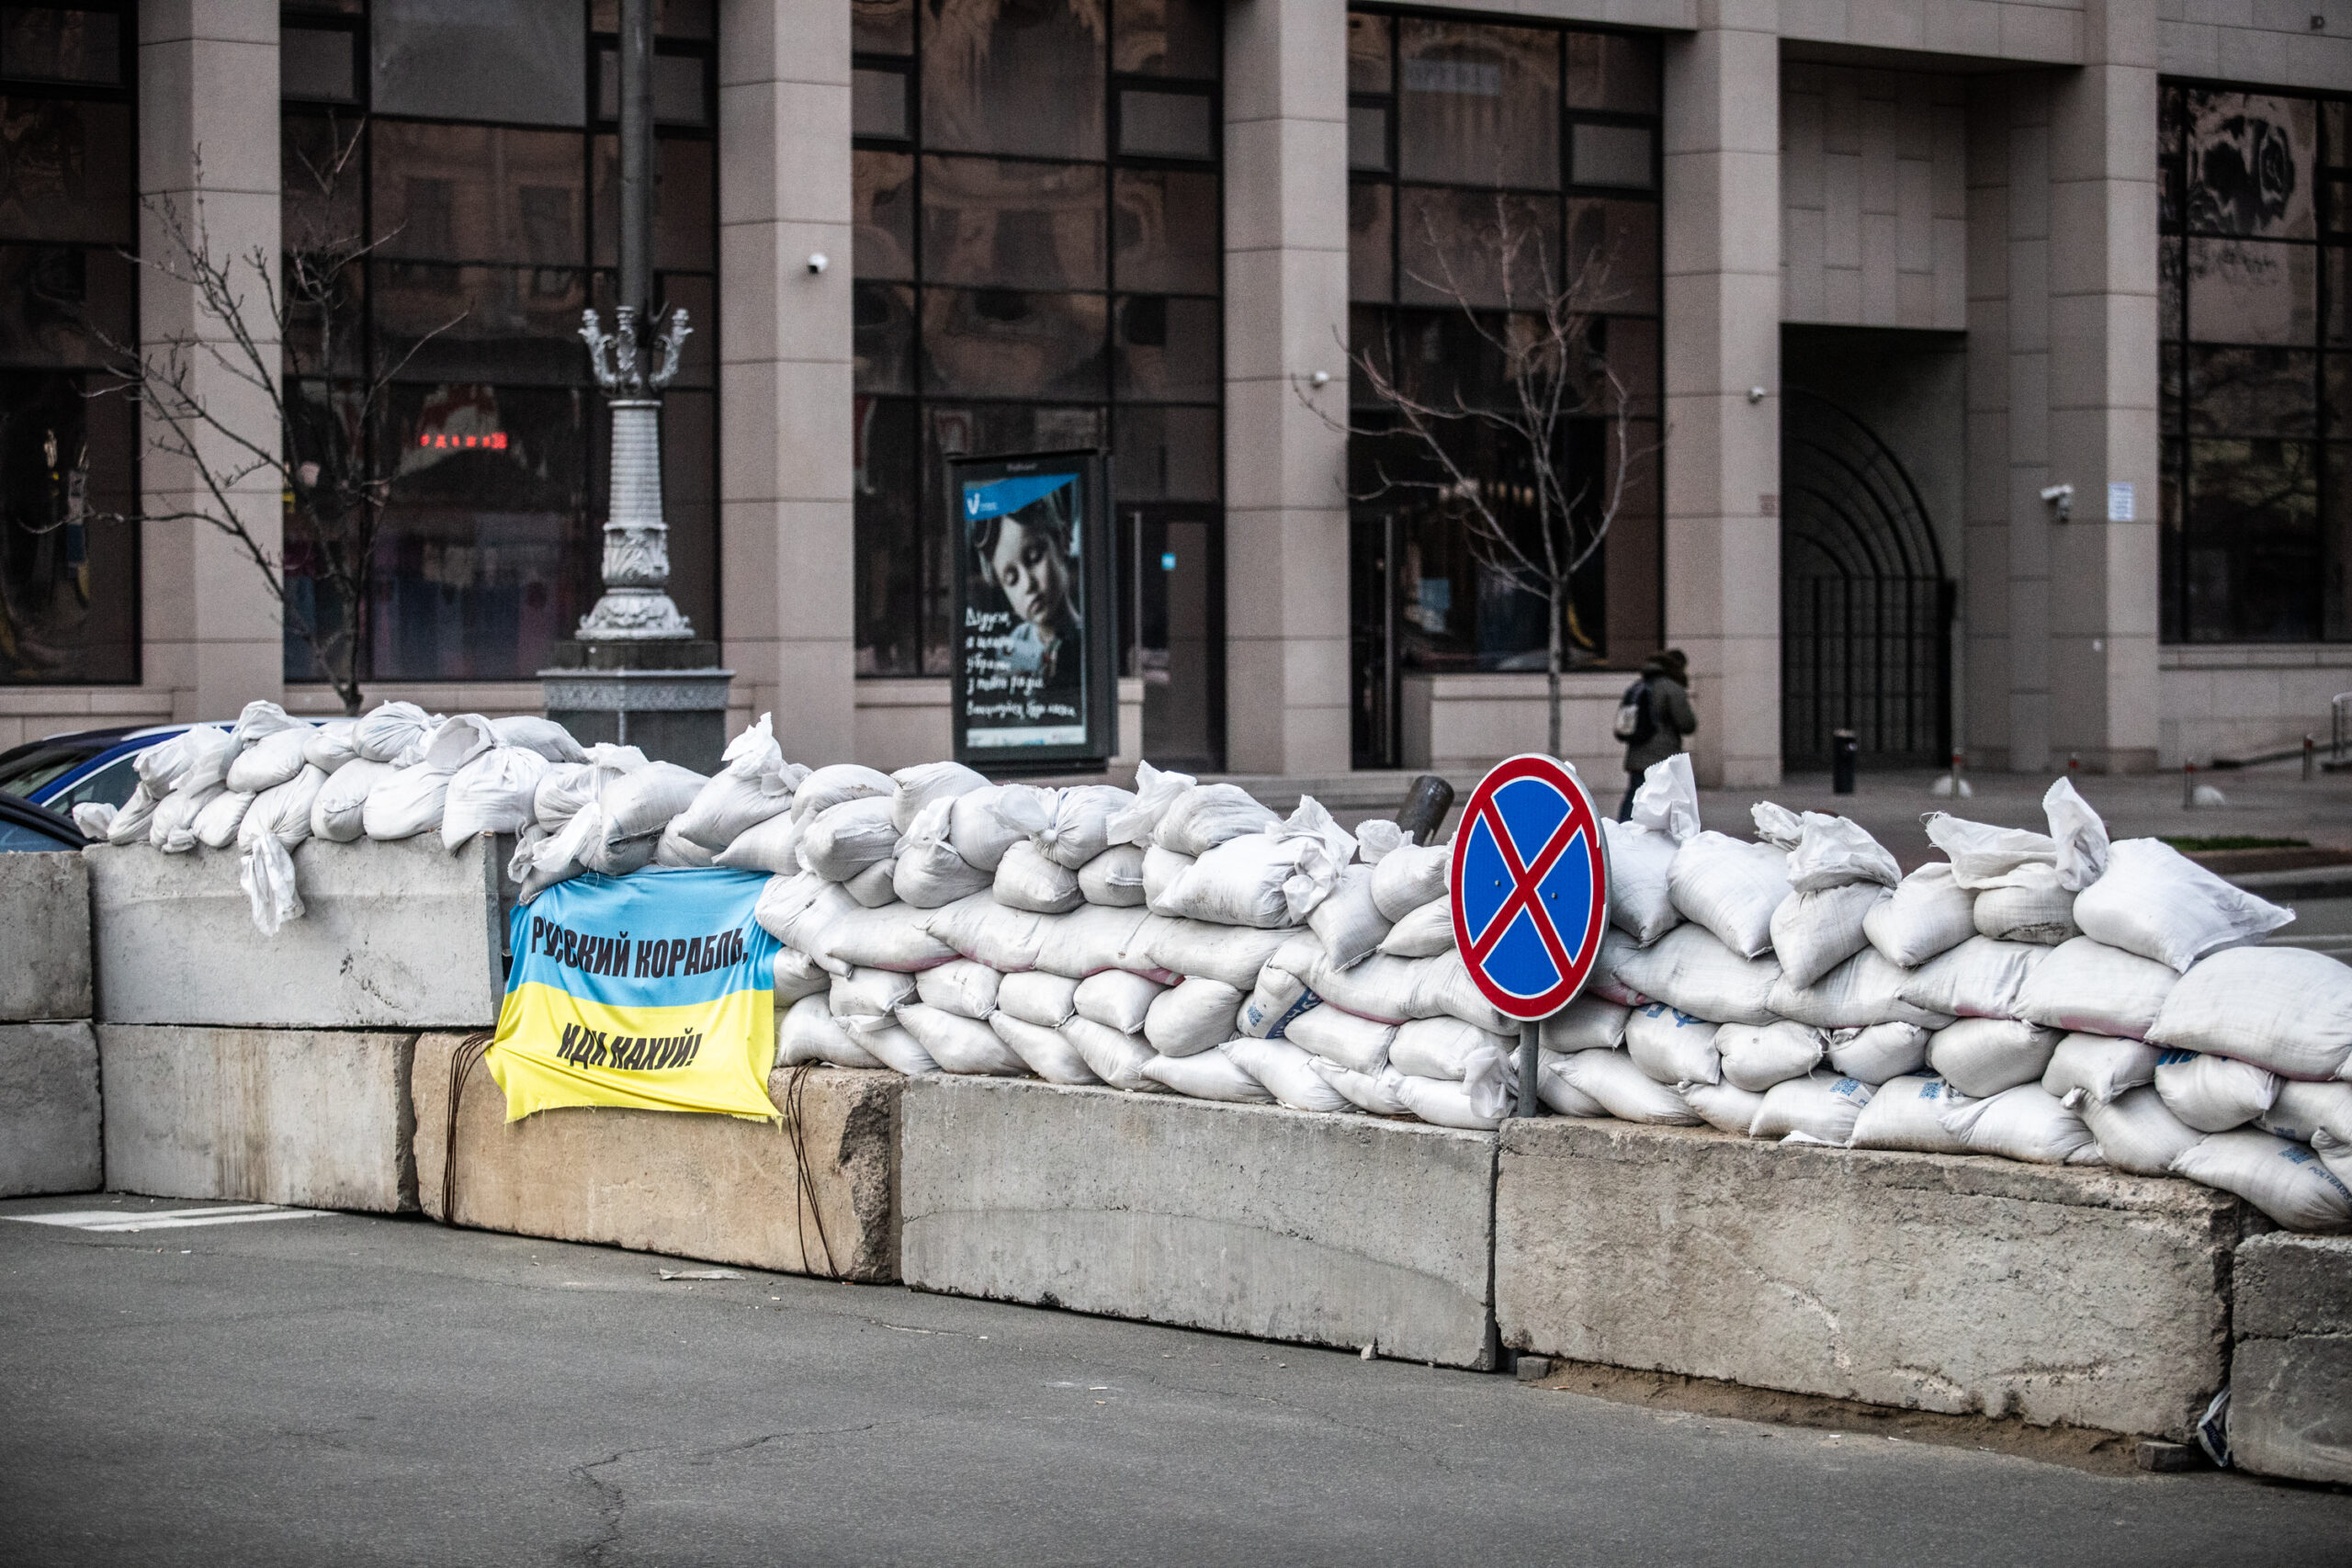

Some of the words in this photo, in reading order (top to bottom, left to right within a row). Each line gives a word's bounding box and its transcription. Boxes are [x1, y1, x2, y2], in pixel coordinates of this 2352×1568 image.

[531, 916, 630, 978] РУССКИЙ
[634, 927, 750, 979] КОРАБЛЬ,
[555, 1022, 608, 1070] ИДИ
[609, 1026, 703, 1071] НАХУЙ!
